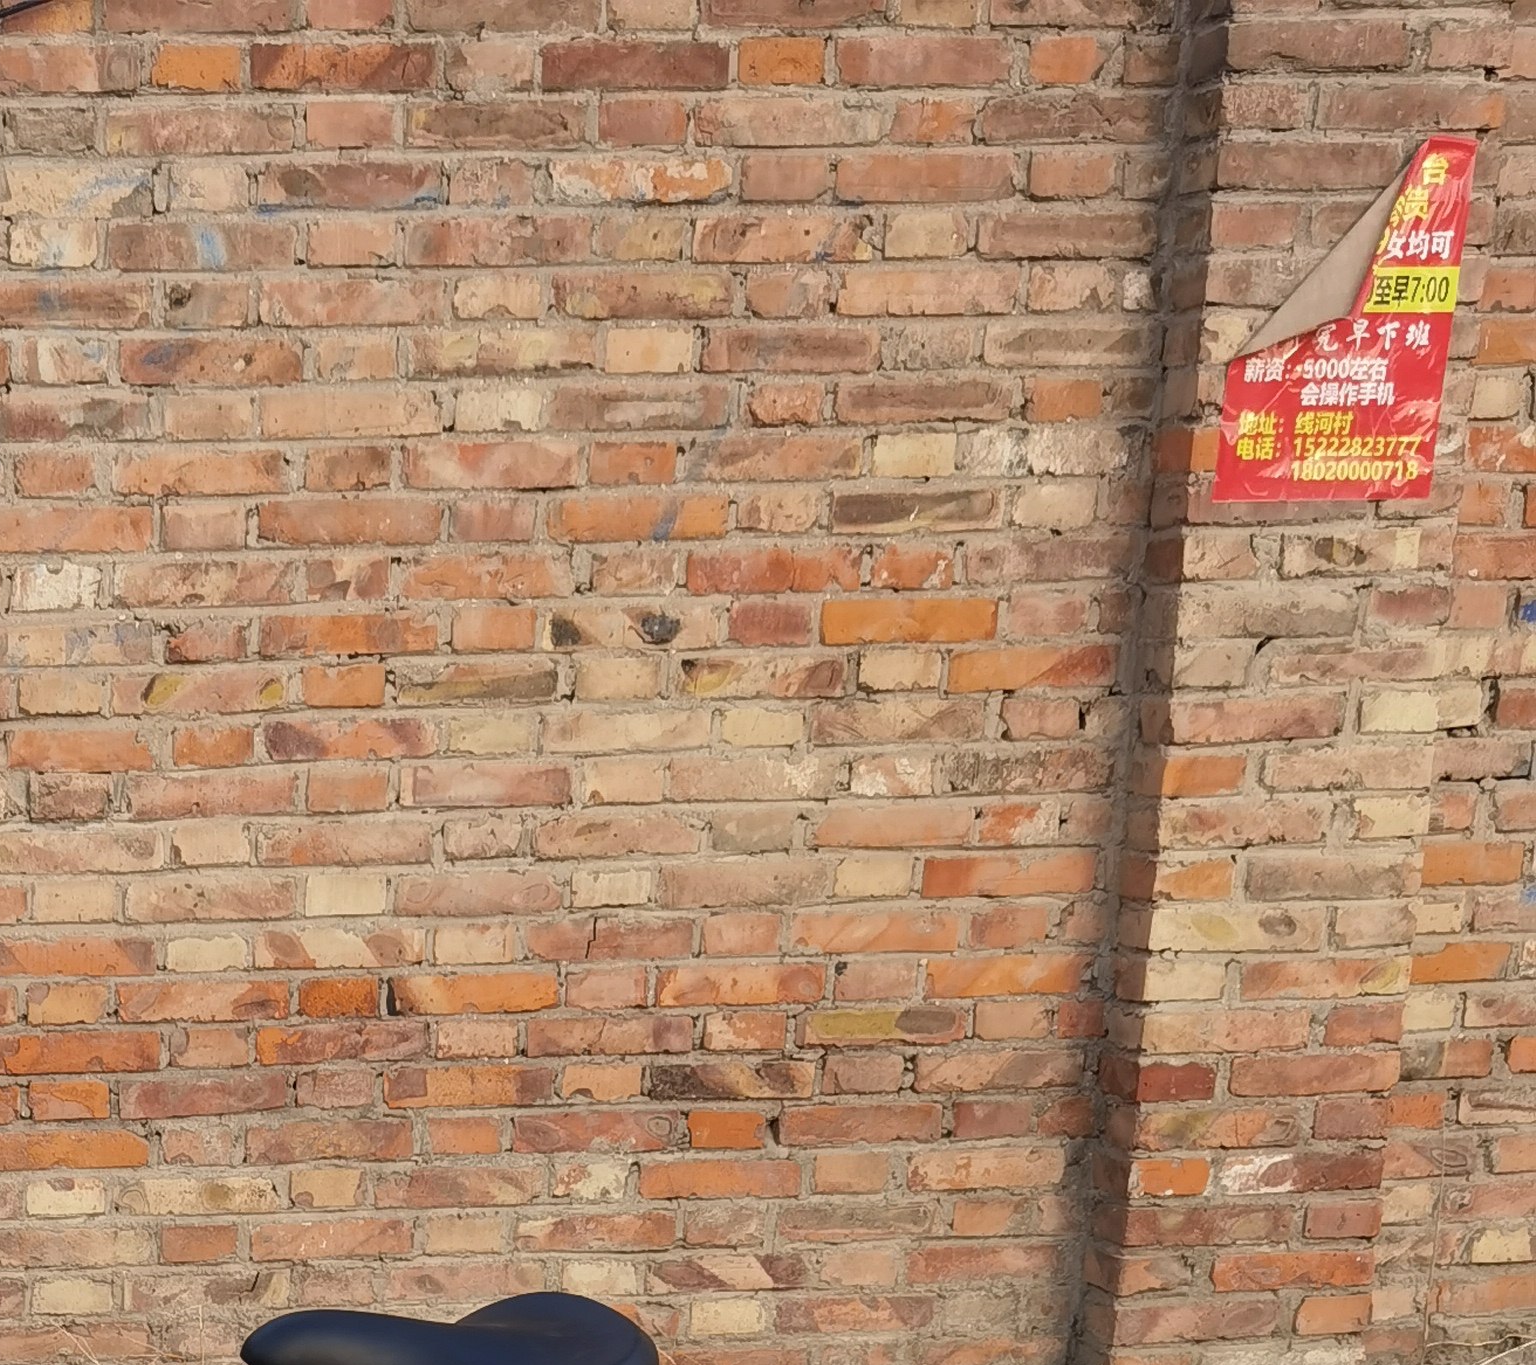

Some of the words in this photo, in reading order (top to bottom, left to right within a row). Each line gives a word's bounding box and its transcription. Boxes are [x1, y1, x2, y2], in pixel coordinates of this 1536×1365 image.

[1300, 382, 1395, 406] 会操作手机
